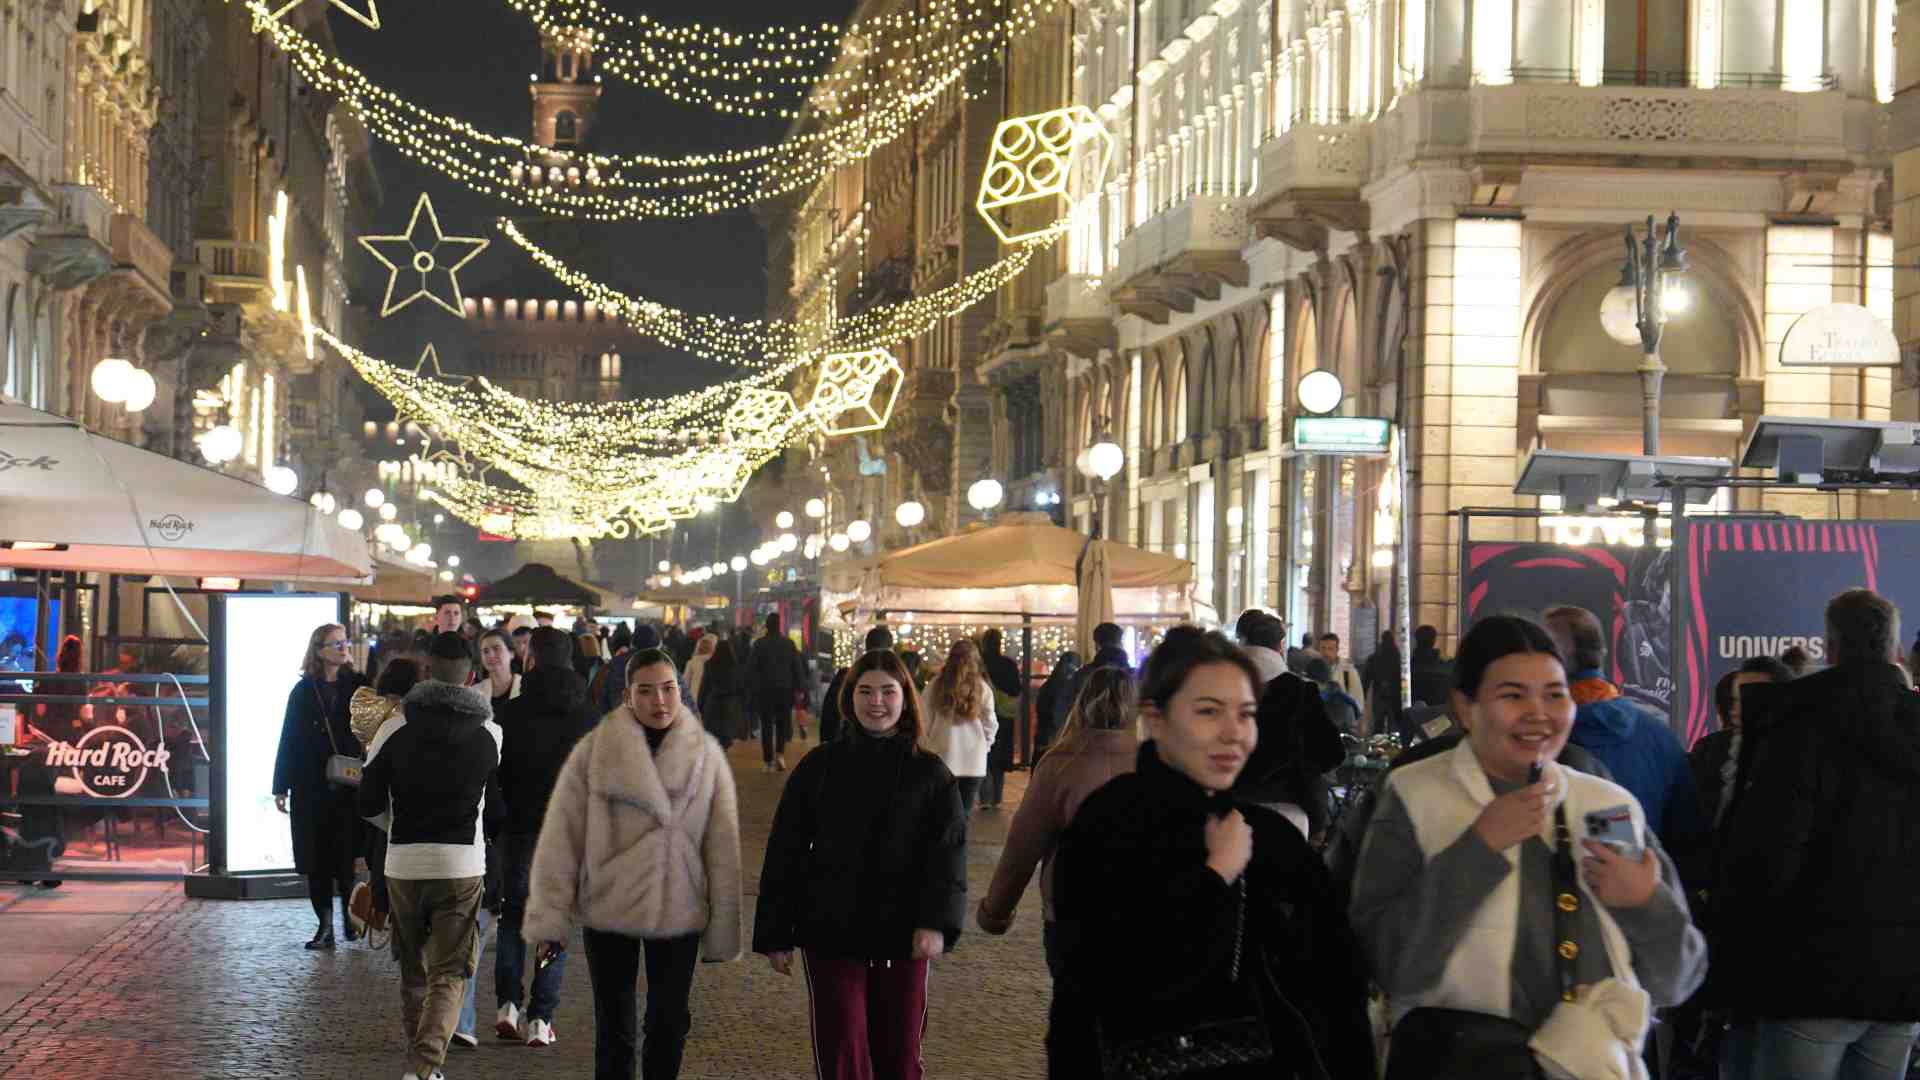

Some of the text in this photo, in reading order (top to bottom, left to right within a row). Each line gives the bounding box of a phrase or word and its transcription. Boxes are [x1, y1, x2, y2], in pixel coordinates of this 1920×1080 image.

[46, 741, 170, 773] Hard Rock
[93, 775, 127, 787] CAFE
